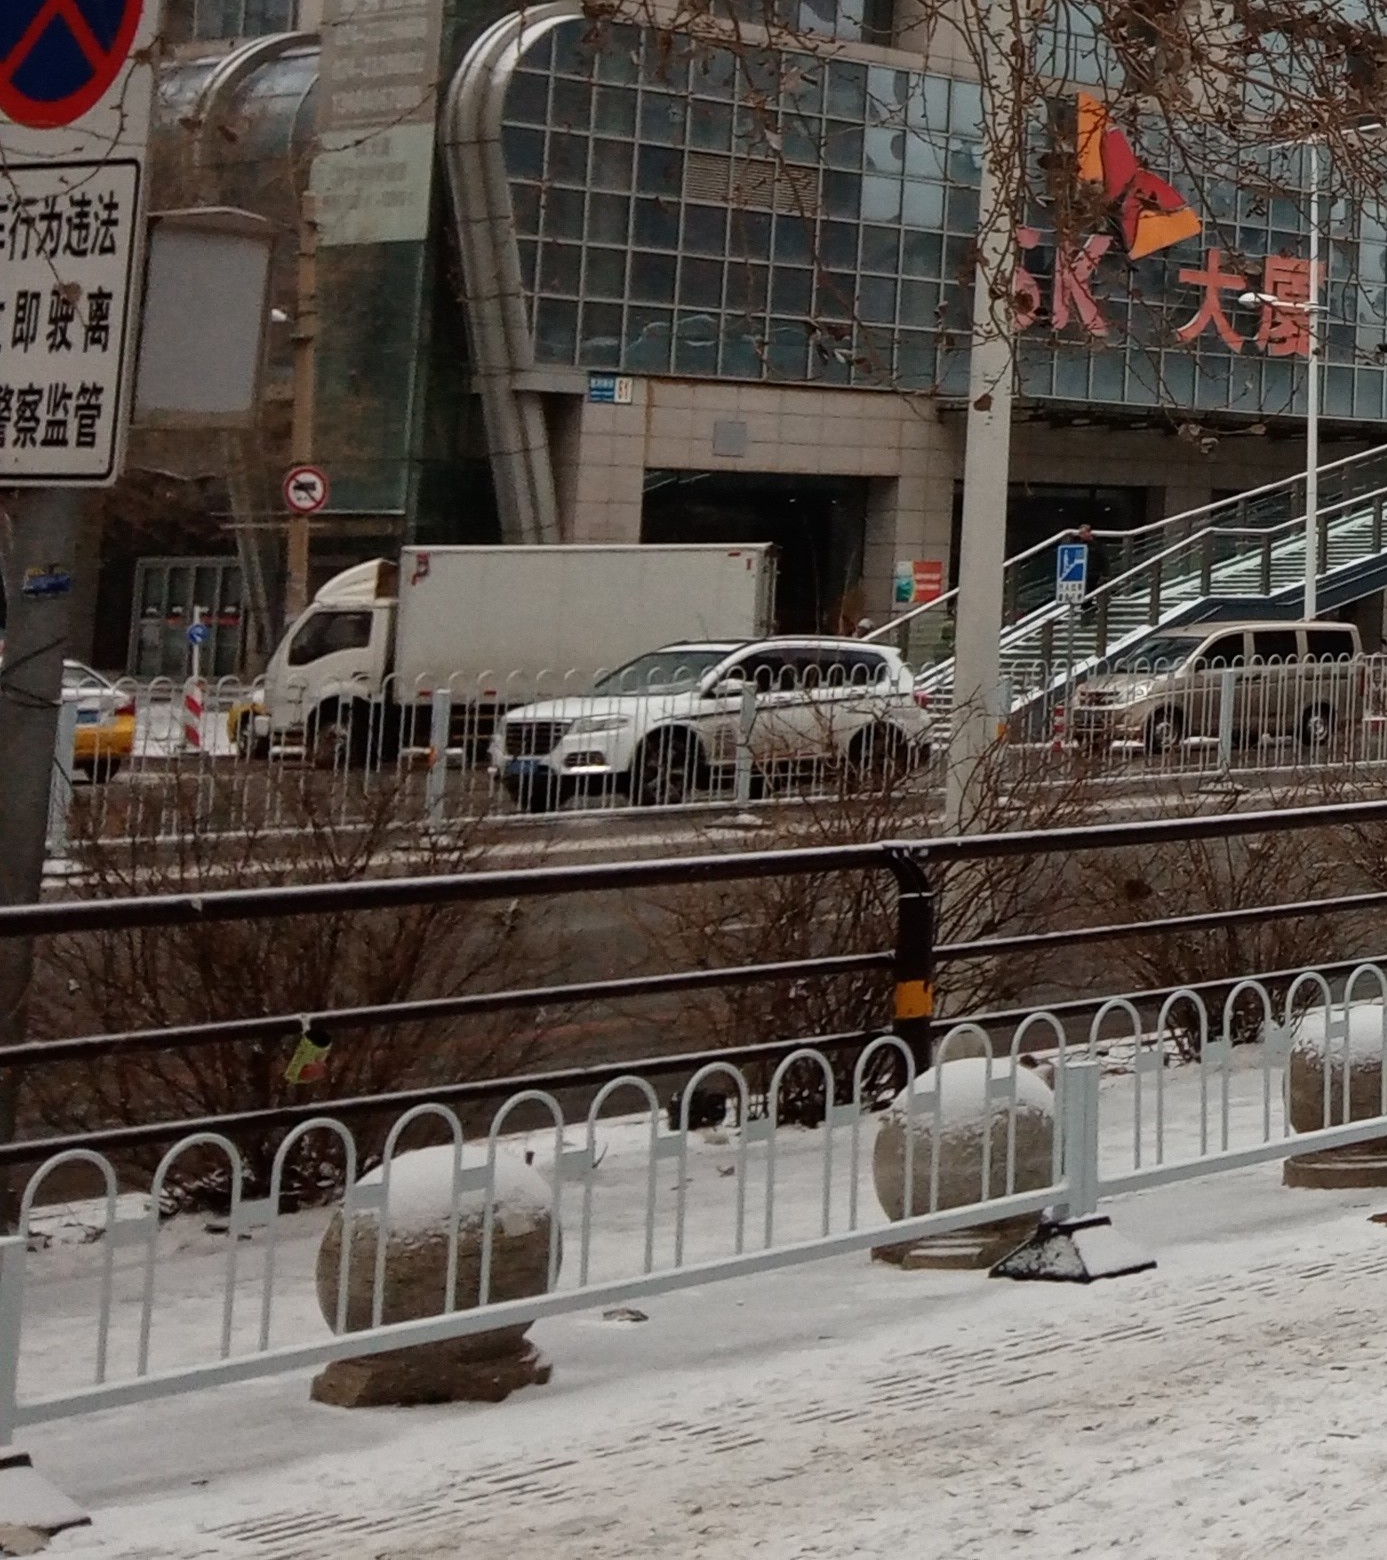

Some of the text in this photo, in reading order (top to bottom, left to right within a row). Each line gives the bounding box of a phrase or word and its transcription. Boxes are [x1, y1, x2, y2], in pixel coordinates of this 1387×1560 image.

[0, 192, 120, 260] 行为违法
[1176, 247, 1328, 358] 大厦
